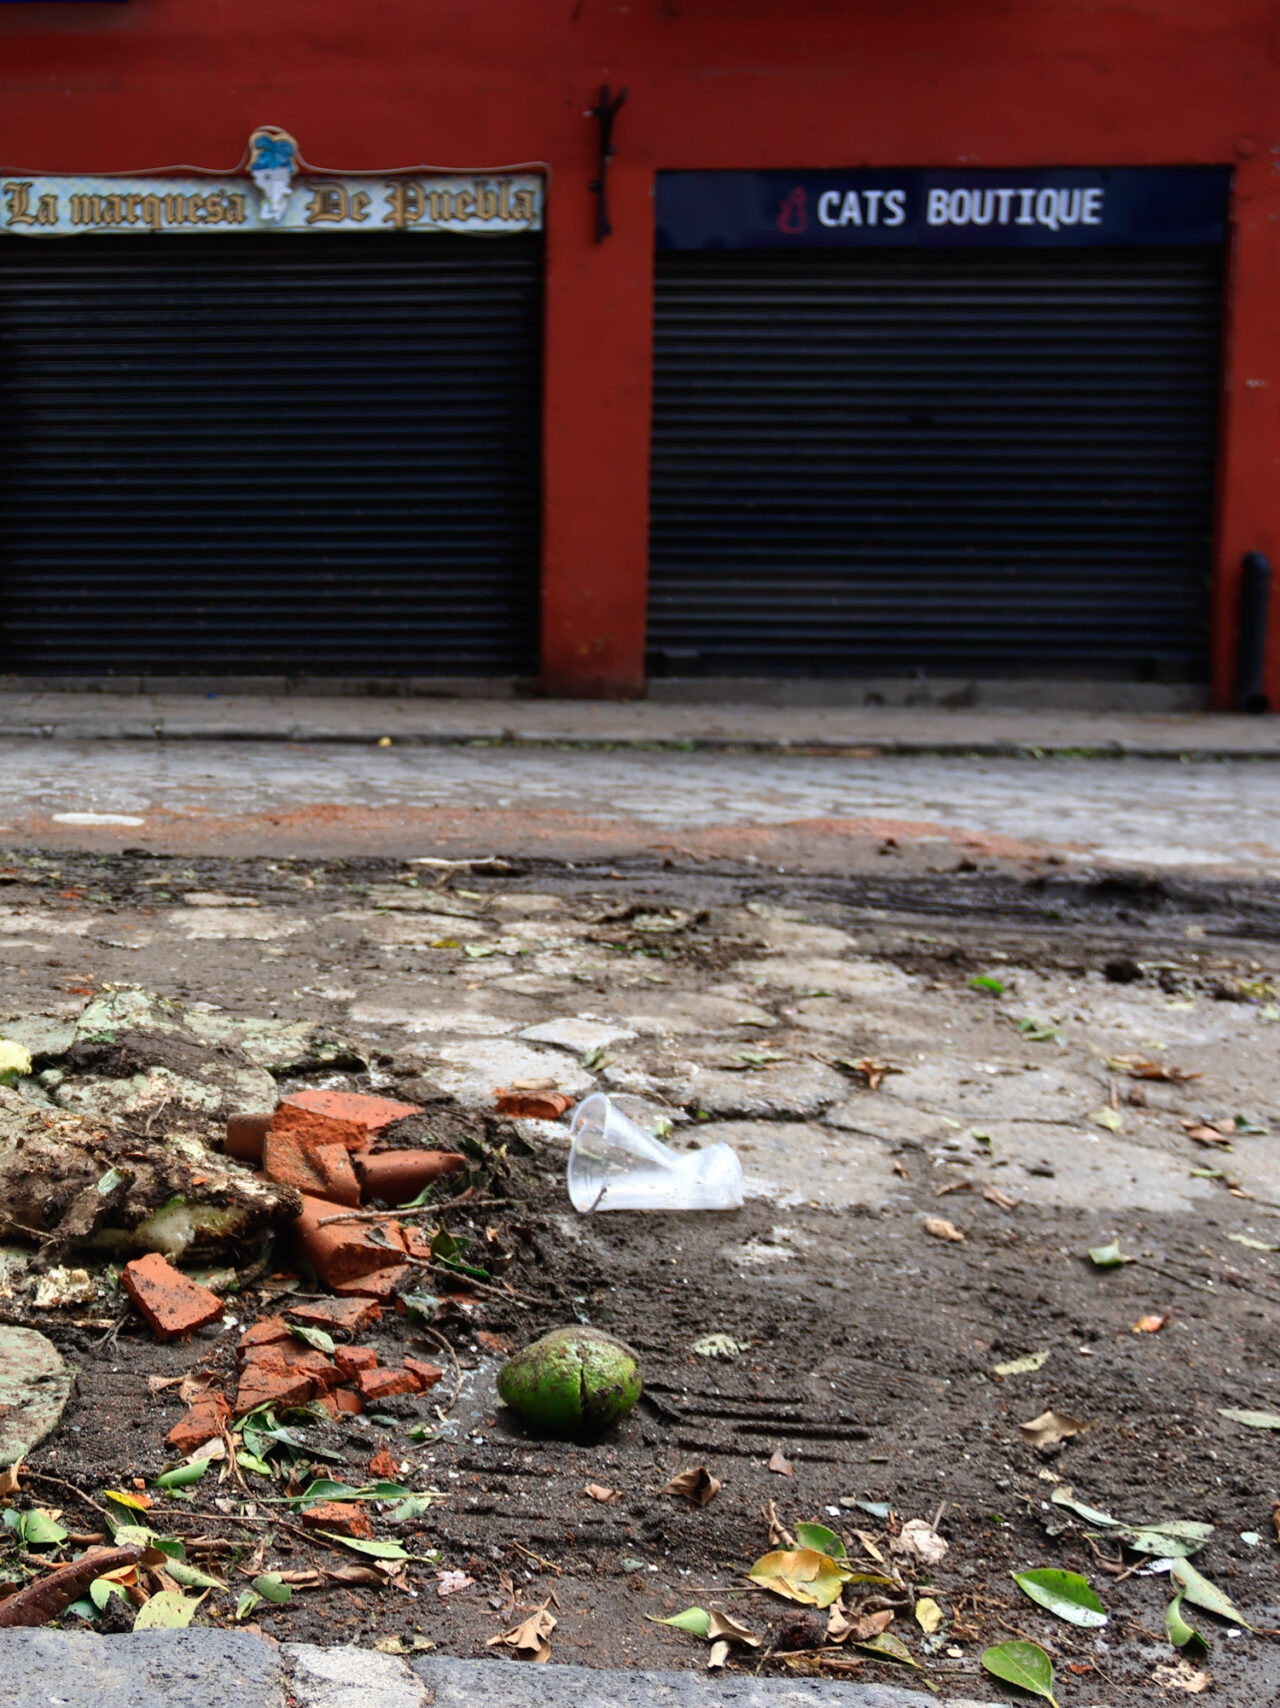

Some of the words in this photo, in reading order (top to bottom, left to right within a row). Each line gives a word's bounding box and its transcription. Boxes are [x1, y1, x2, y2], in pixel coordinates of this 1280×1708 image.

[3, 182, 59, 226] La
[70, 189, 247, 231] marquesa
[305, 181, 371, 224] De
[383, 179, 537, 230] Puebla
[818, 190, 906, 227] CATS
[927, 188, 1104, 231] BOUTIQUE
